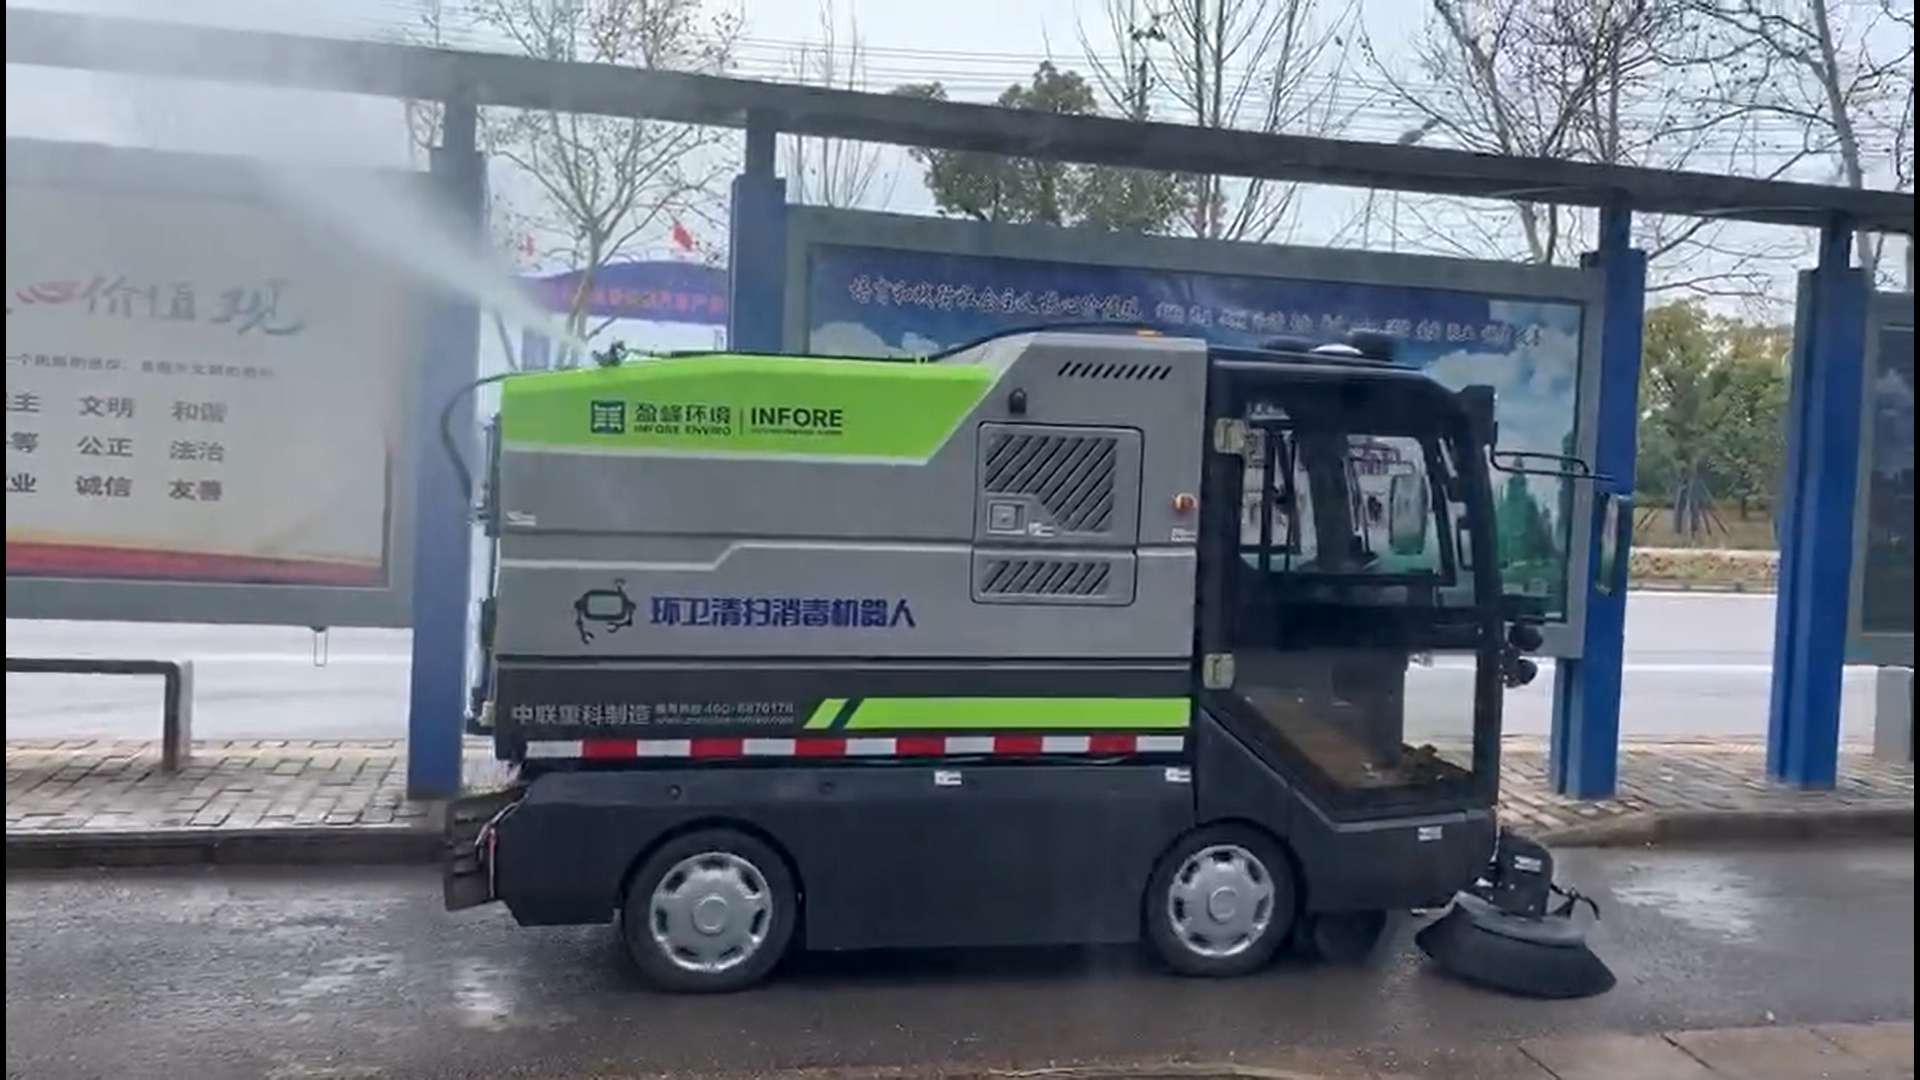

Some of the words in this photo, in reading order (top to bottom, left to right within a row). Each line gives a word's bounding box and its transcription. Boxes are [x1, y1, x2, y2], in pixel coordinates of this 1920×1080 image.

[6, 274, 304, 335] 心价值观
[6, 394, 40, 413] 主
[79, 396, 134, 418] 文明
[751, 406, 843, 428] INFORE
[6, 432, 39, 453] 等
[77, 435, 133, 458] 公正
[169, 441, 225, 462] 法治
[6, 473, 37, 493] 业
[75, 475, 132, 497] 诚信
[649, 596, 917, 628] 环卫清扫消毒机器人
[511, 704, 651, 727] 中联重科制造
